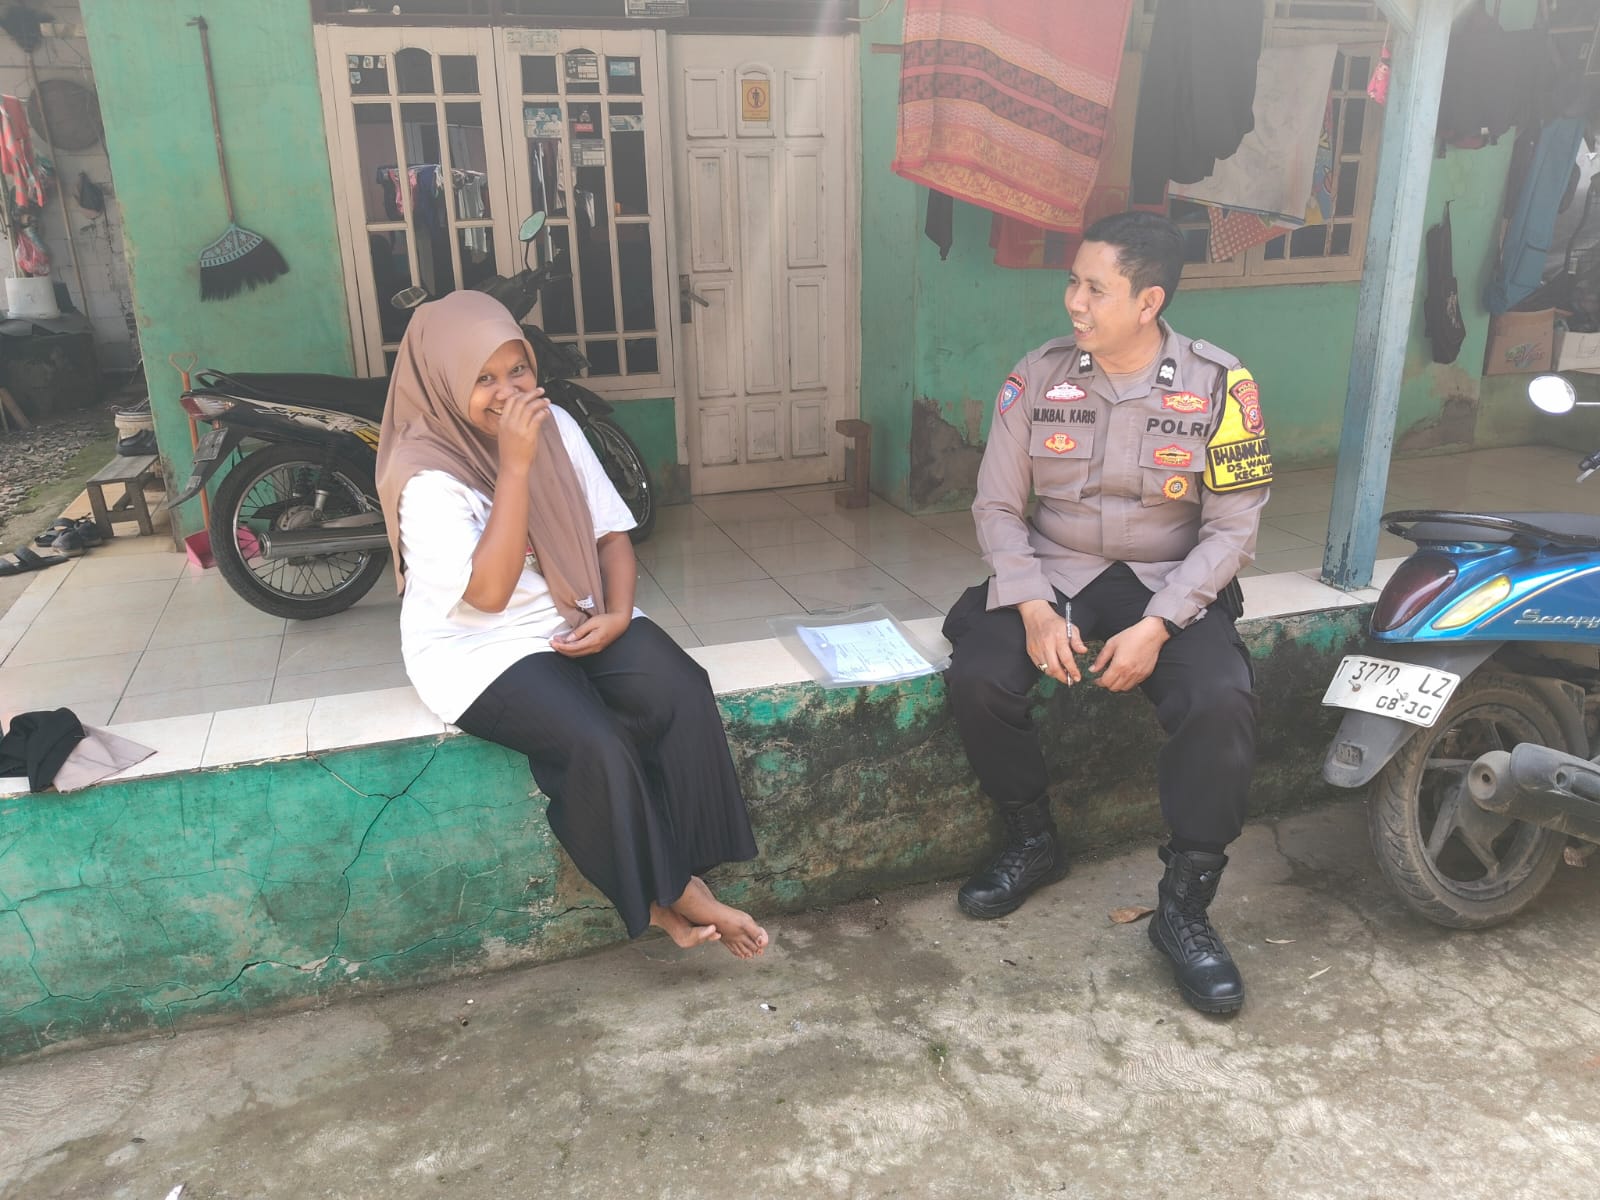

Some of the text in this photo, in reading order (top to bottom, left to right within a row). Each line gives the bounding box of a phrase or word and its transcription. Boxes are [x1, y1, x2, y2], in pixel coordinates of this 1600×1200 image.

[1069, 409, 1096, 425] KARIS
[1146, 418, 1211, 437] POLRI
[1235, 469, 1260, 480] KEC.
[1514, 608, 1600, 629] Scoopy
[1351, 661, 1401, 685] 3779
[1418, 673, 1452, 699] LZ
